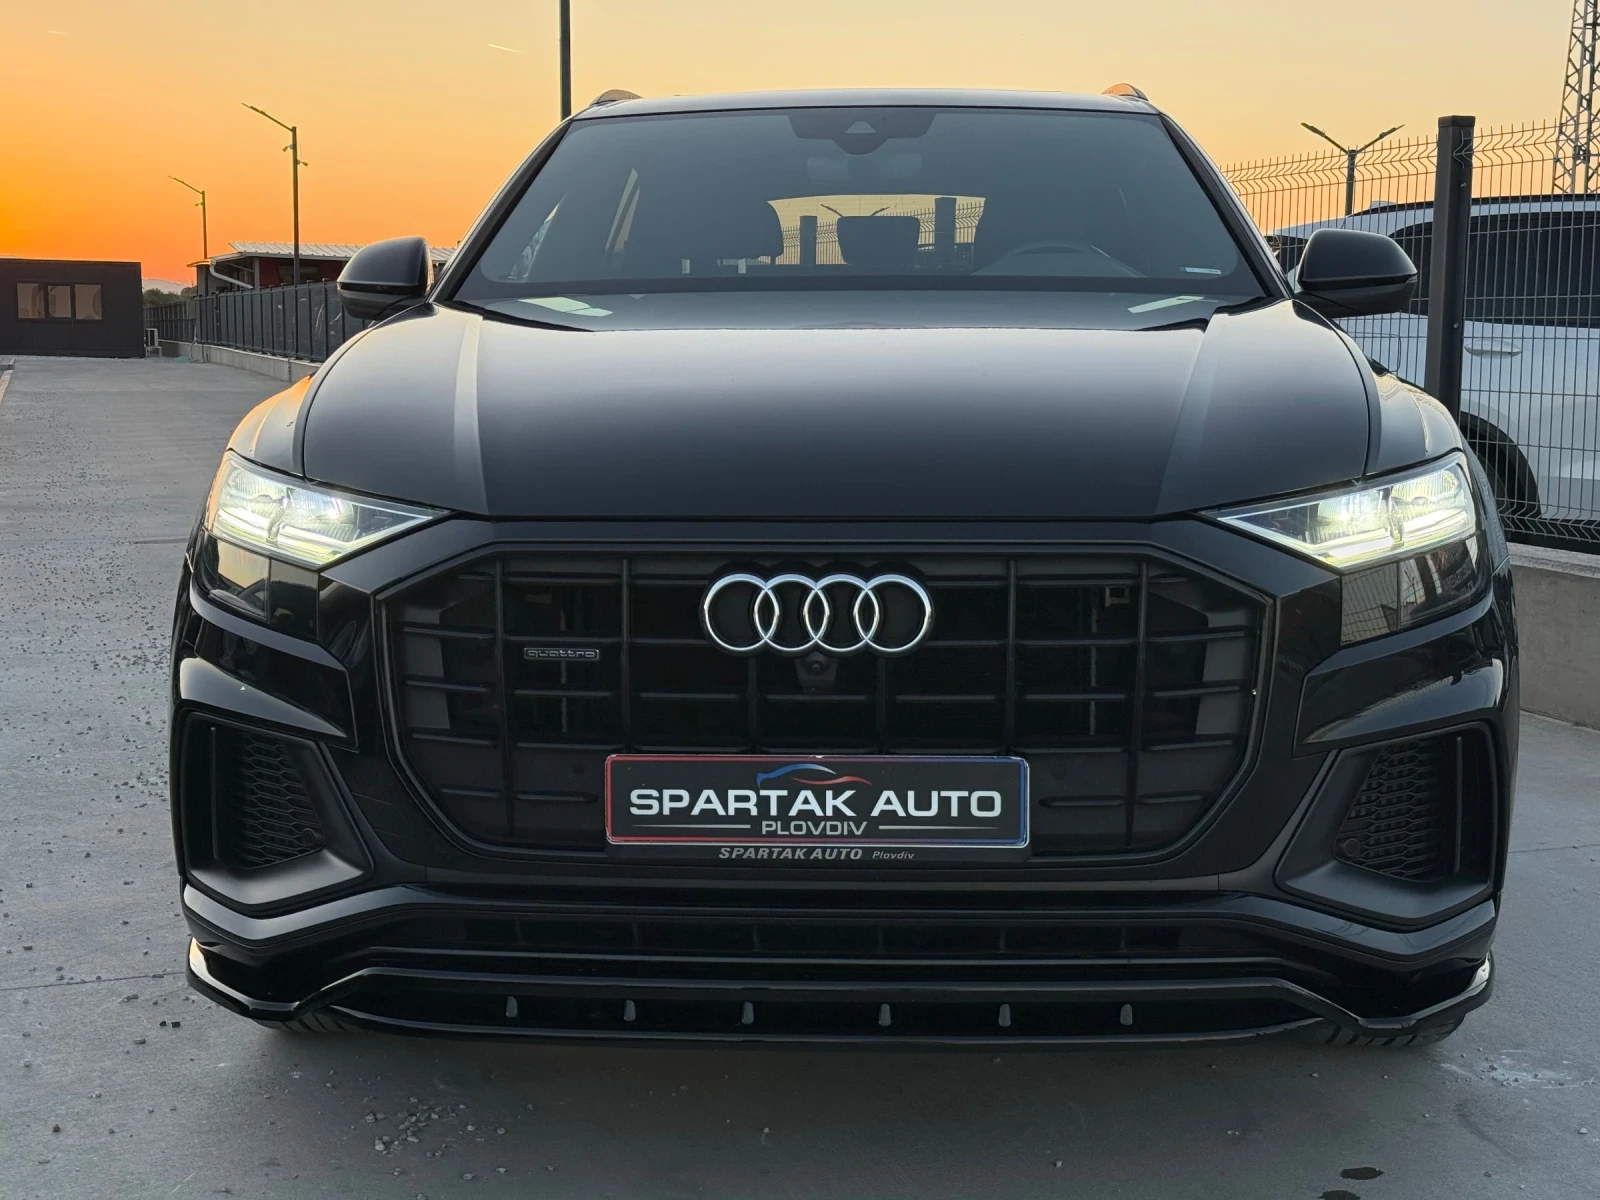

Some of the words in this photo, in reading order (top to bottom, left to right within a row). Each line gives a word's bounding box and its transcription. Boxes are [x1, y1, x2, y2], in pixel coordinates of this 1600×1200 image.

[527, 649, 596, 658] quattro
[629, 788, 857, 818] SPARTAK
[870, 789, 1002, 818] AUTO
[761, 820, 868, 836] PLOVDIV
[718, 847, 808, 860] SPARTAK
[809, 848, 863, 860] AUTO
[871, 850, 916, 860] Plovdiv
